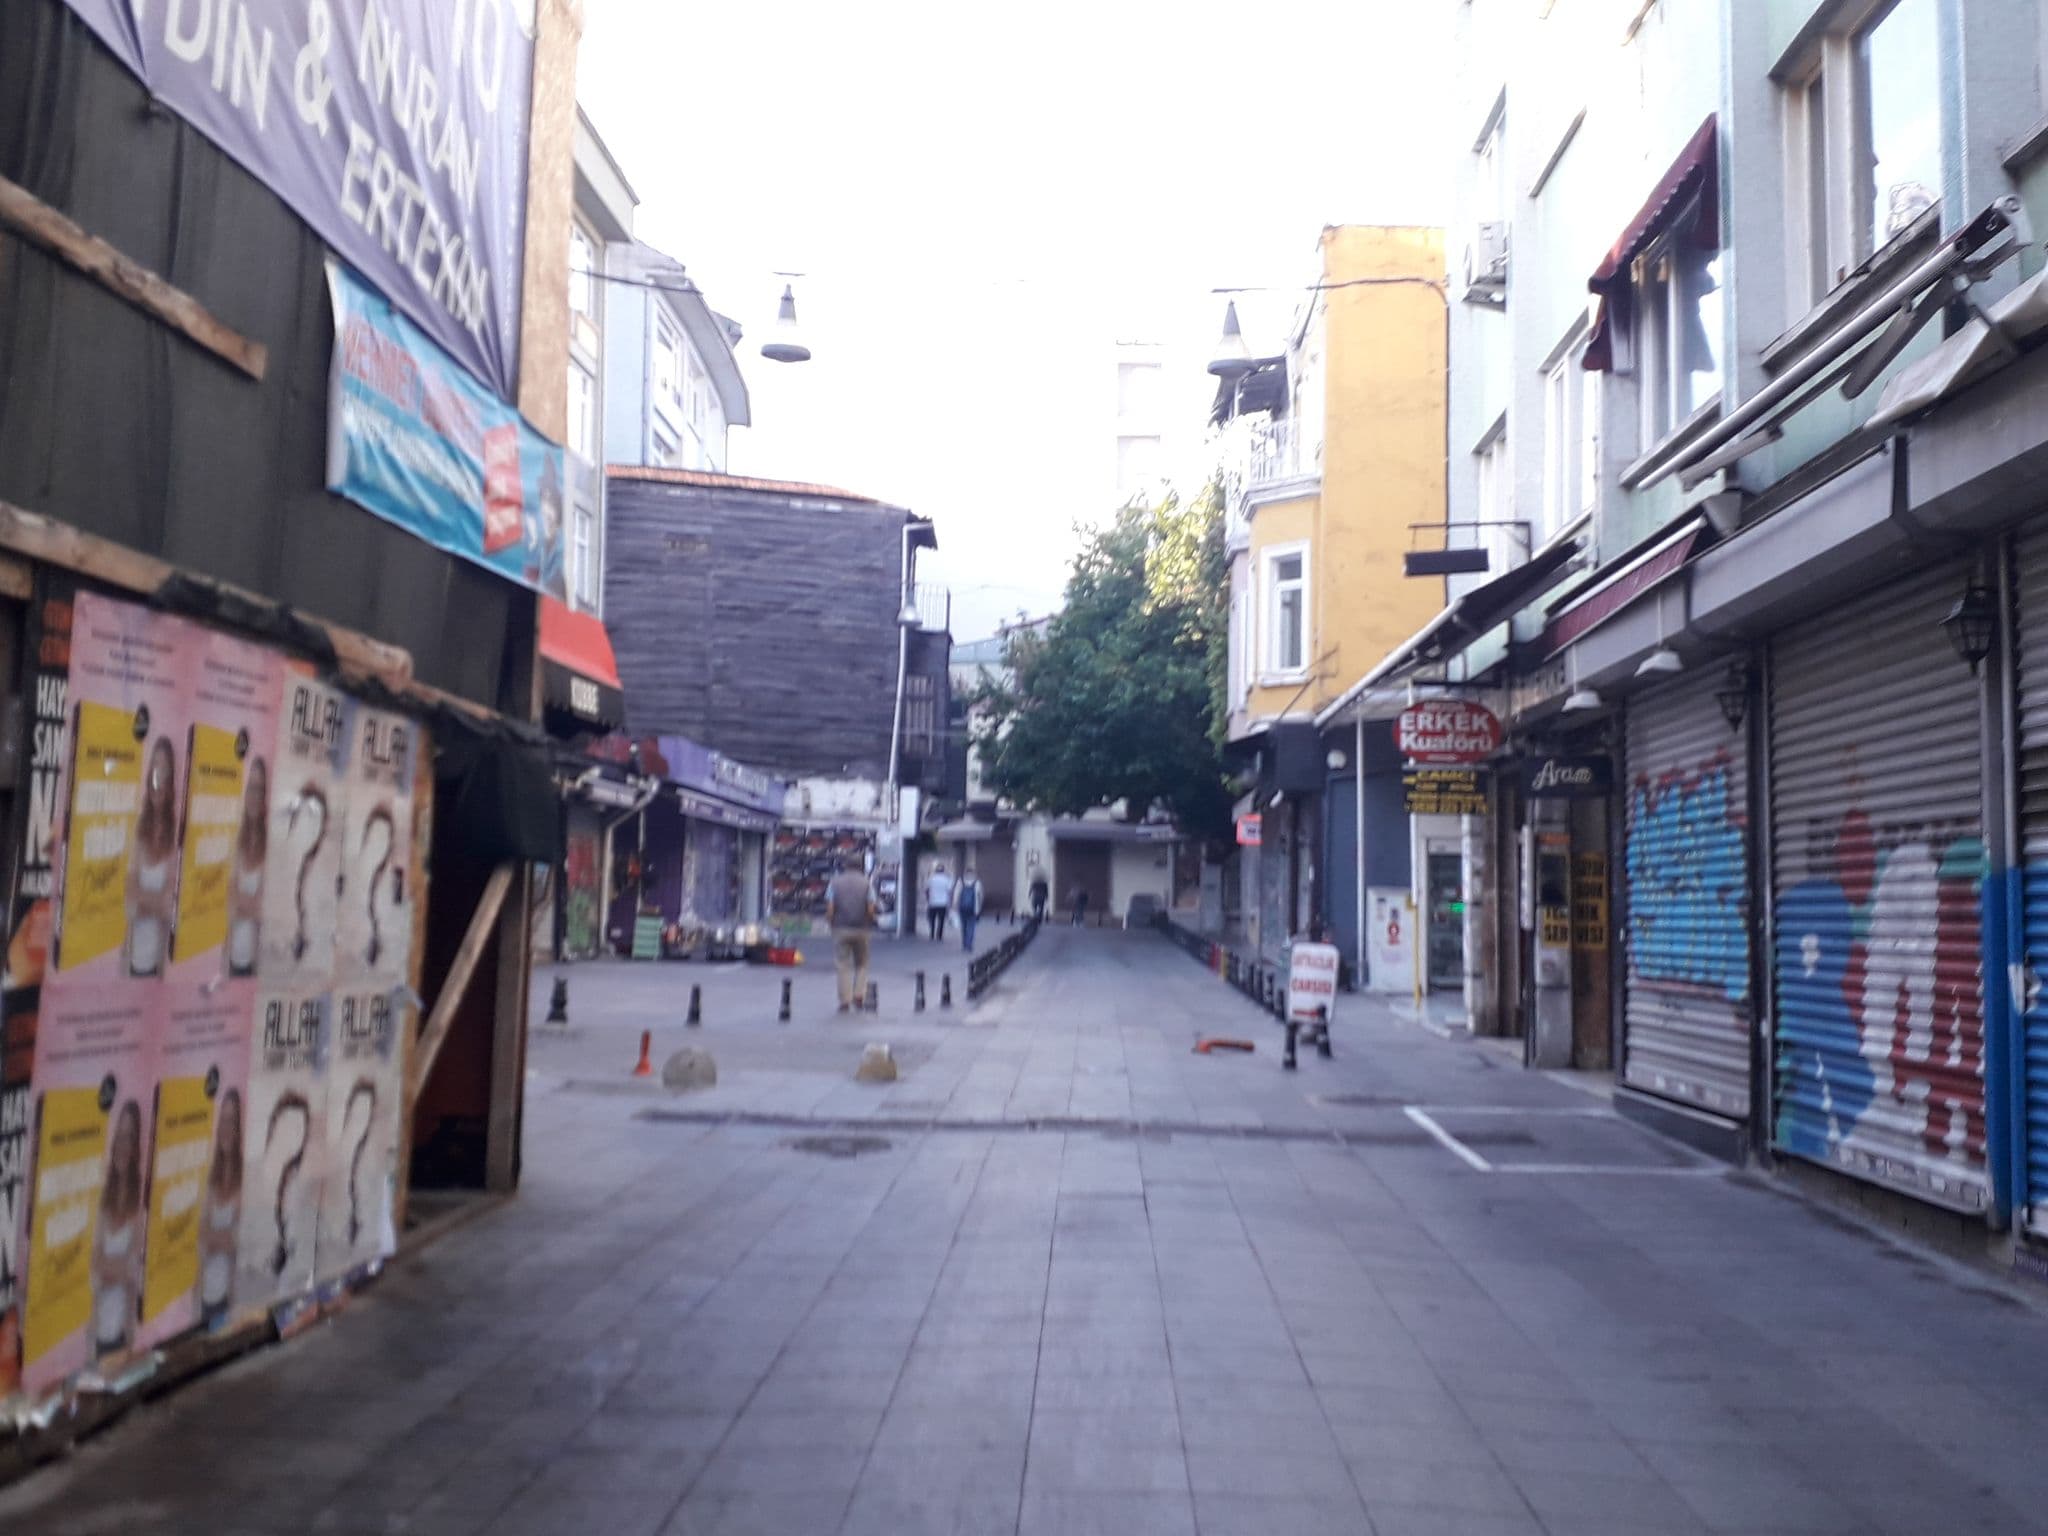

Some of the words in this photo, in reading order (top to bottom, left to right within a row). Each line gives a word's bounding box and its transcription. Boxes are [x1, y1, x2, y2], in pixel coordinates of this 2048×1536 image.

[131, 0, 272, 131] DIN
[359, 2, 479, 213] NURAN
[1400, 710, 1489, 731] ERKEK
[1400, 731, 1493, 752] Kuaförü
